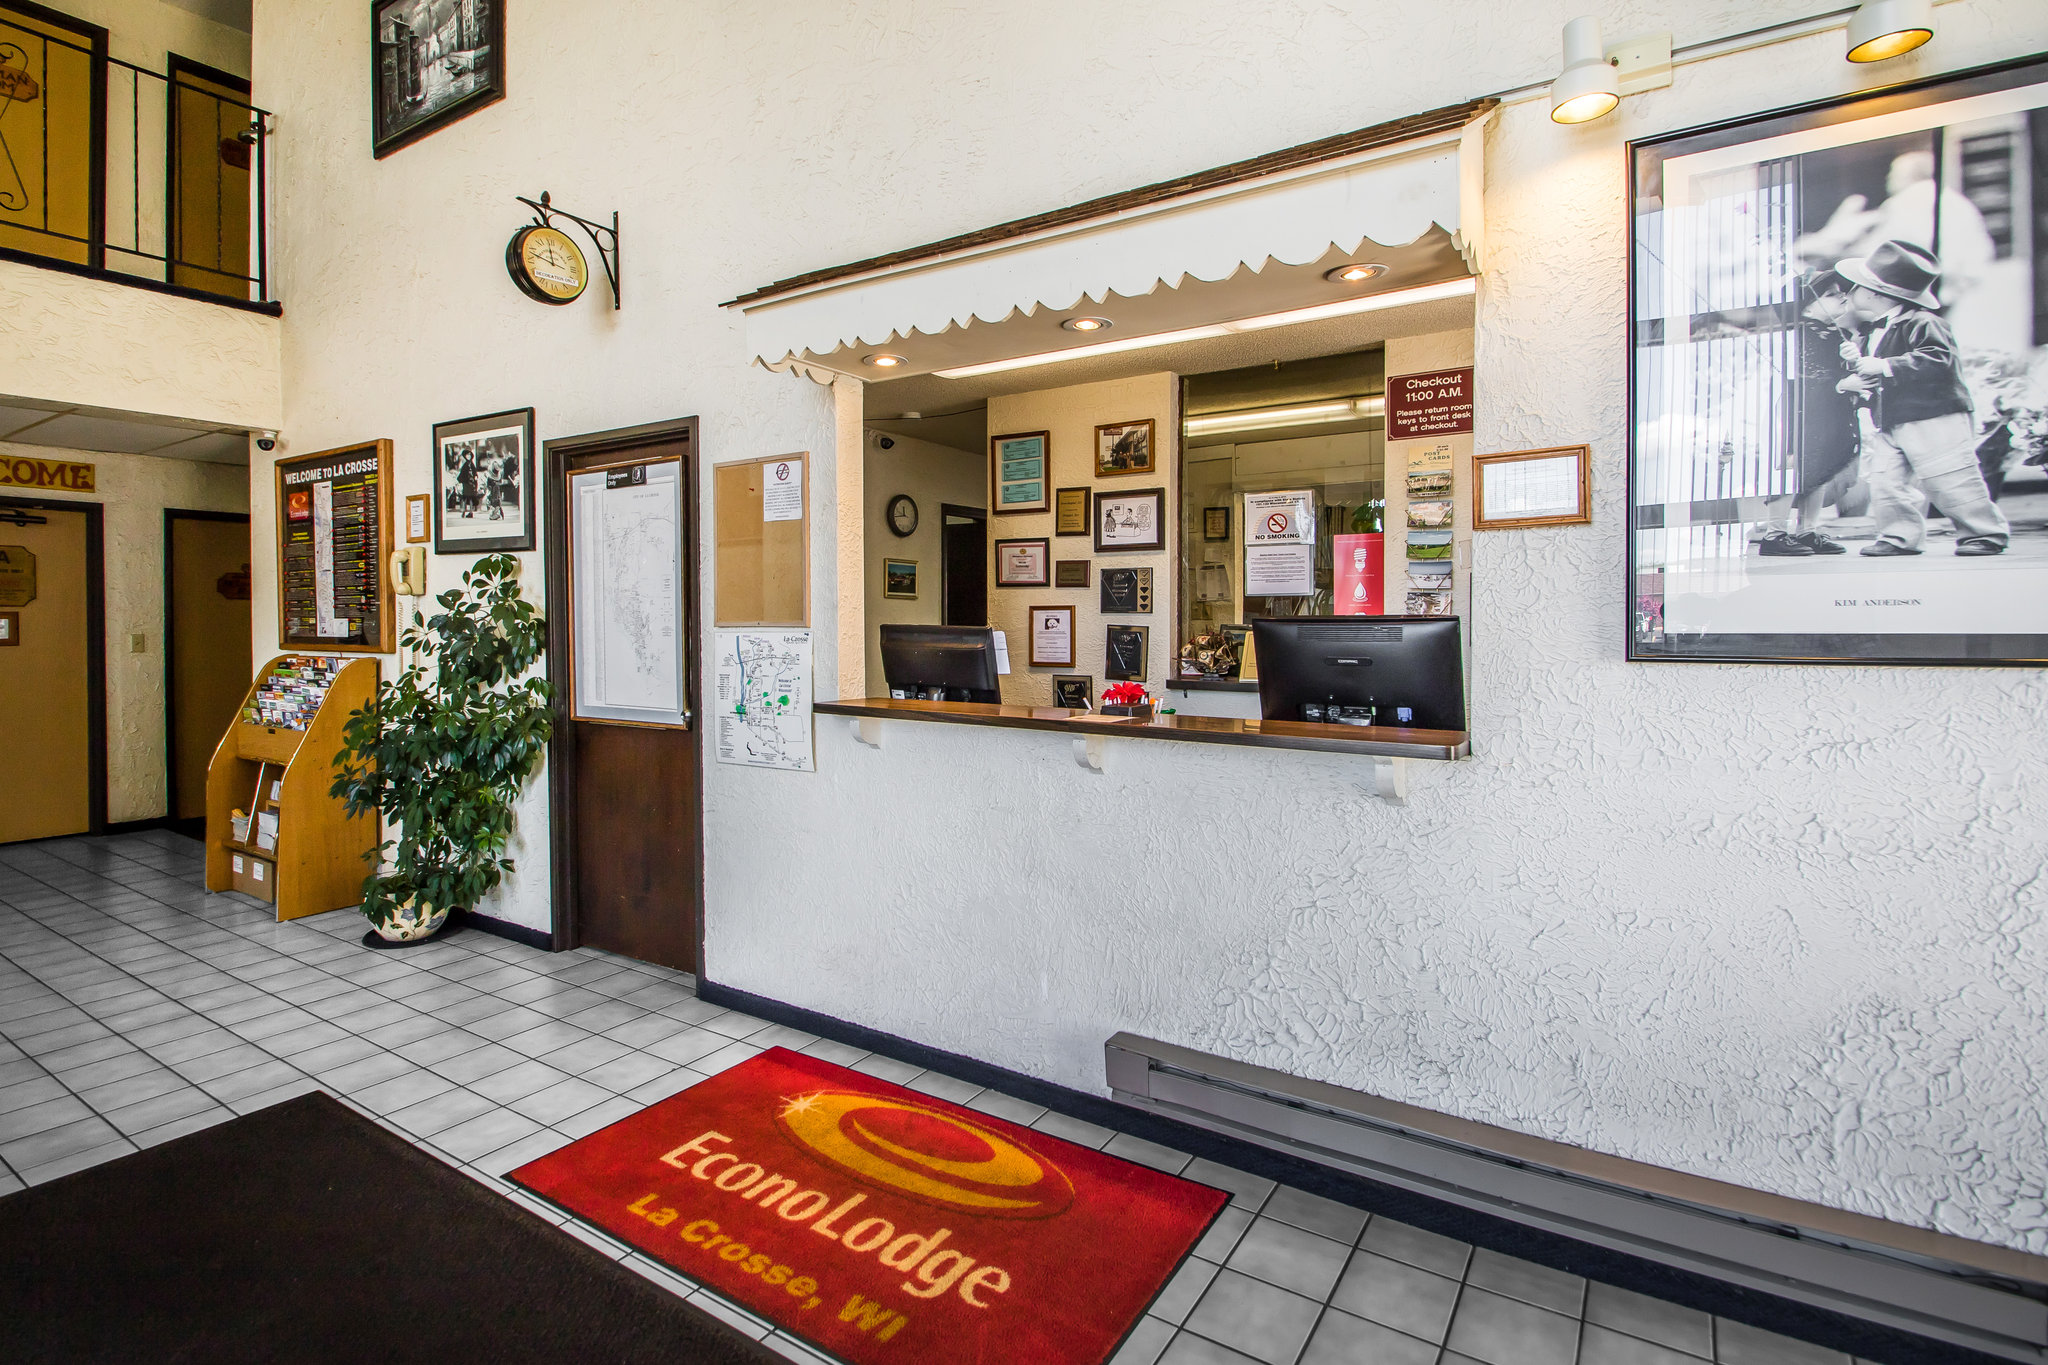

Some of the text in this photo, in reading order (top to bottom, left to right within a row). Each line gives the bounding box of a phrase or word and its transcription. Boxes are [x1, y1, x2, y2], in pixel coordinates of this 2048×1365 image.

[1406, 374, 1462, 389] Checkout
[1406, 387, 1463, 402] 11:00 A.M.
[1420, 421, 1458, 430] checkout.
[285, 458, 378, 485] WELCOME TO LA CROSSE
[660, 1130, 1011, 1309] EconoLodge
[627, 1193, 909, 1343] La Crosse, WI
